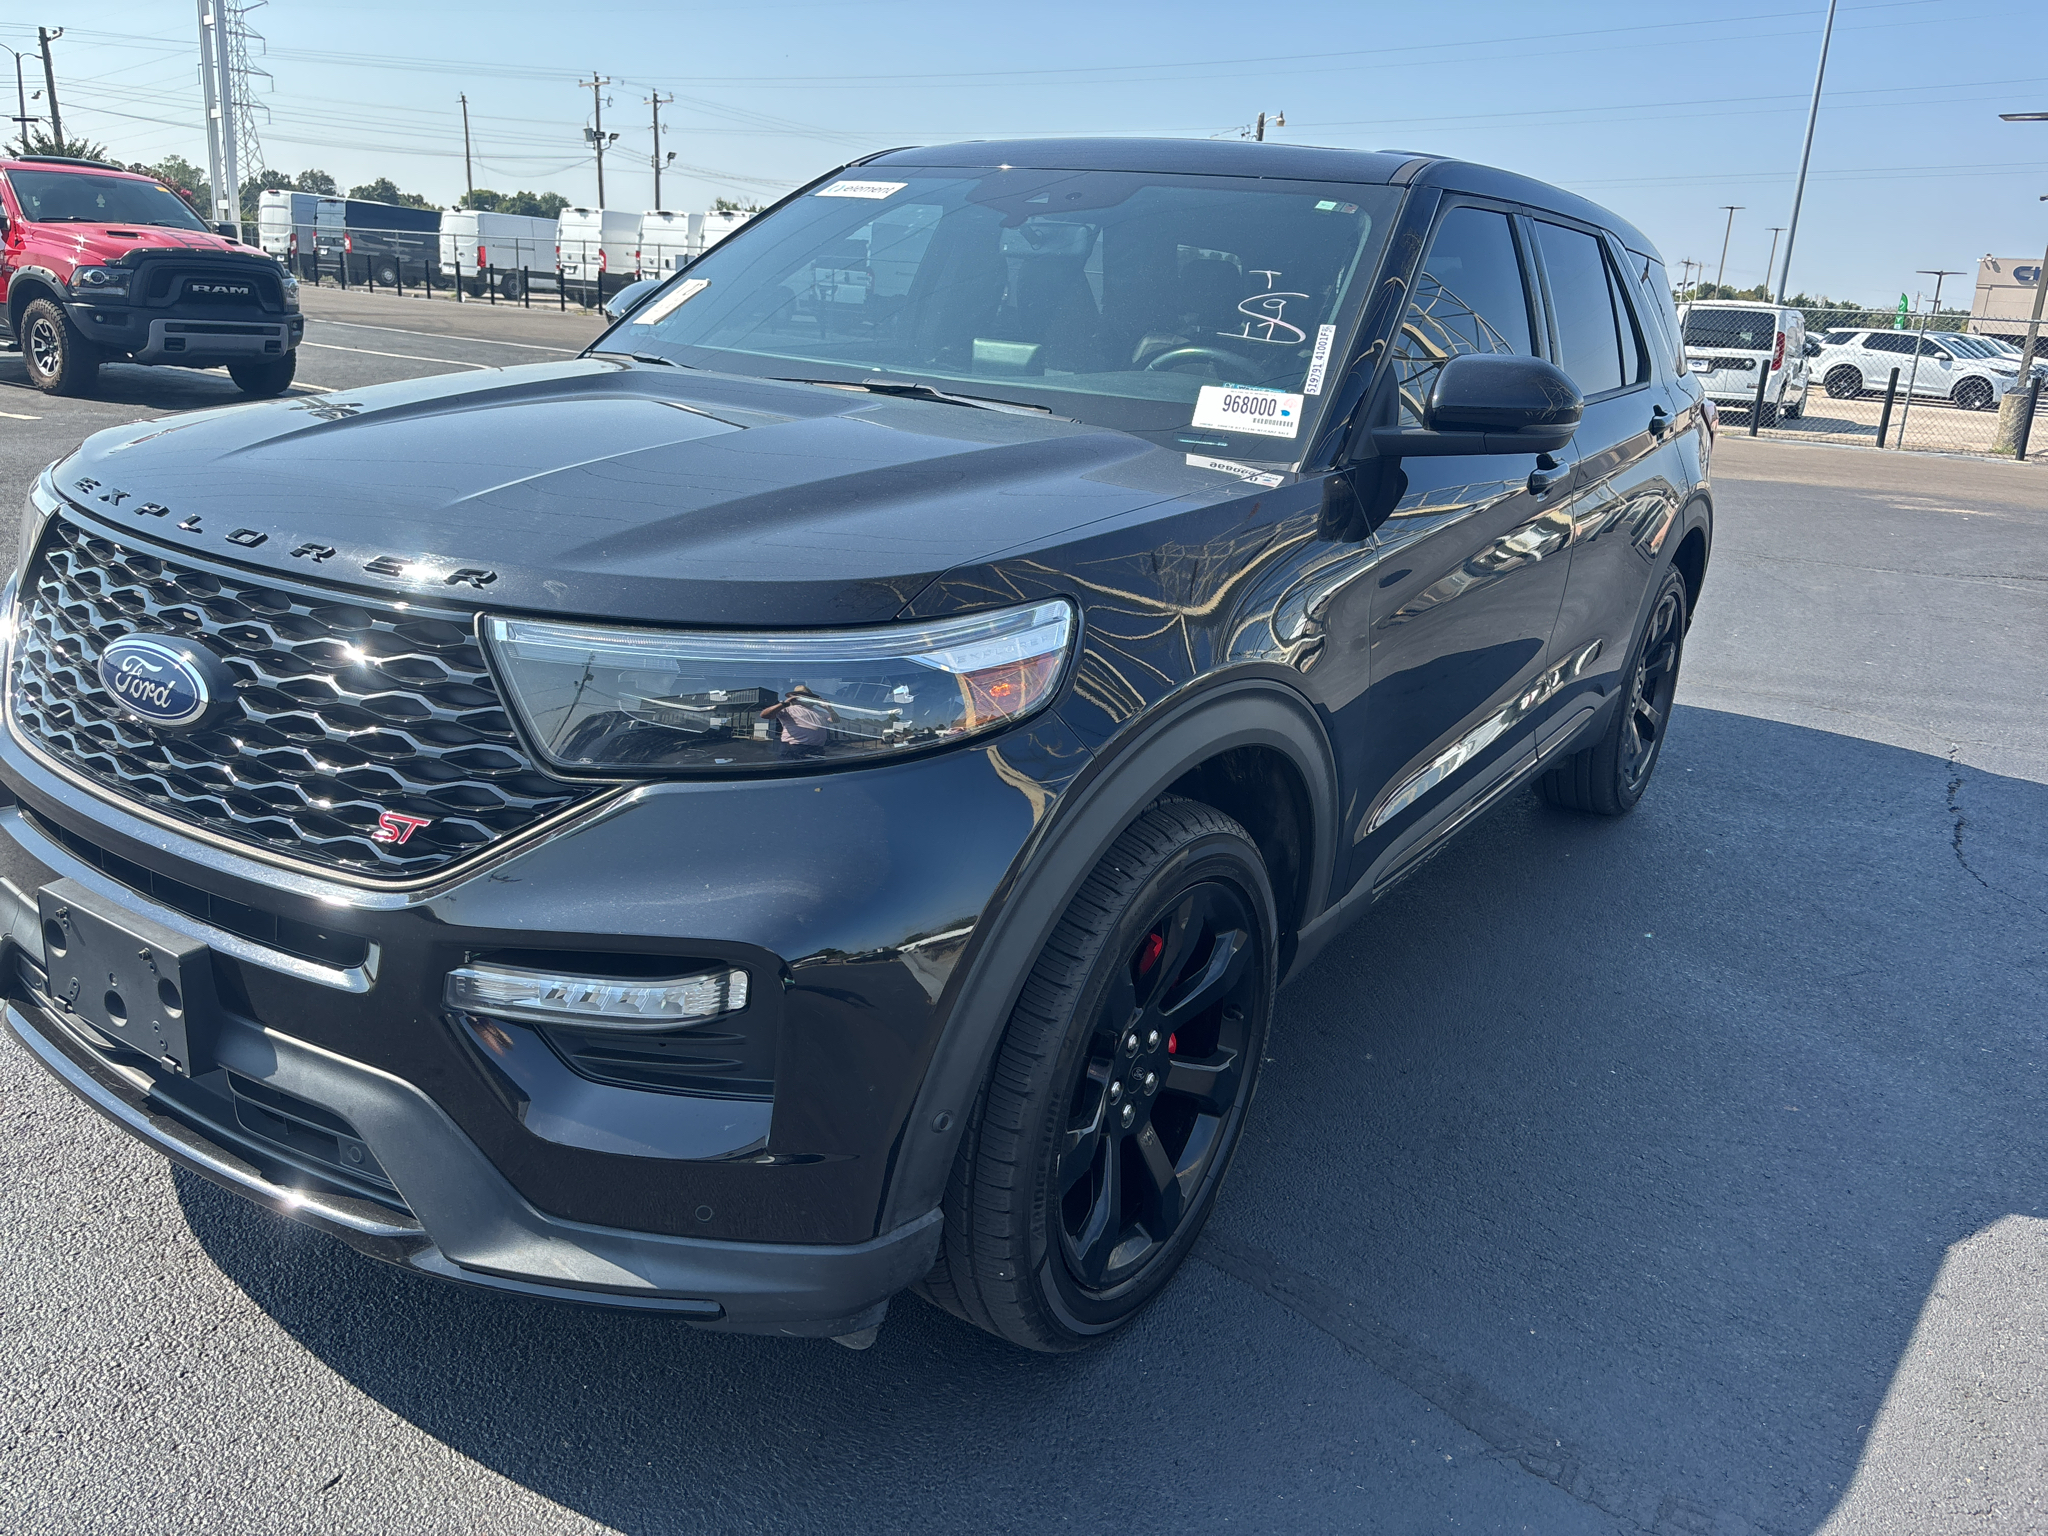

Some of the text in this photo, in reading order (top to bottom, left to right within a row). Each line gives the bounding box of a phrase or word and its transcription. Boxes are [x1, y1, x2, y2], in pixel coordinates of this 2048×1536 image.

[192, 283, 249, 295] RAM
[1222, 394, 1277, 417] 968000
[72, 476, 498, 590] EXPLORER
[113, 654, 177, 710] Ford
[371, 809, 432, 845] ST
